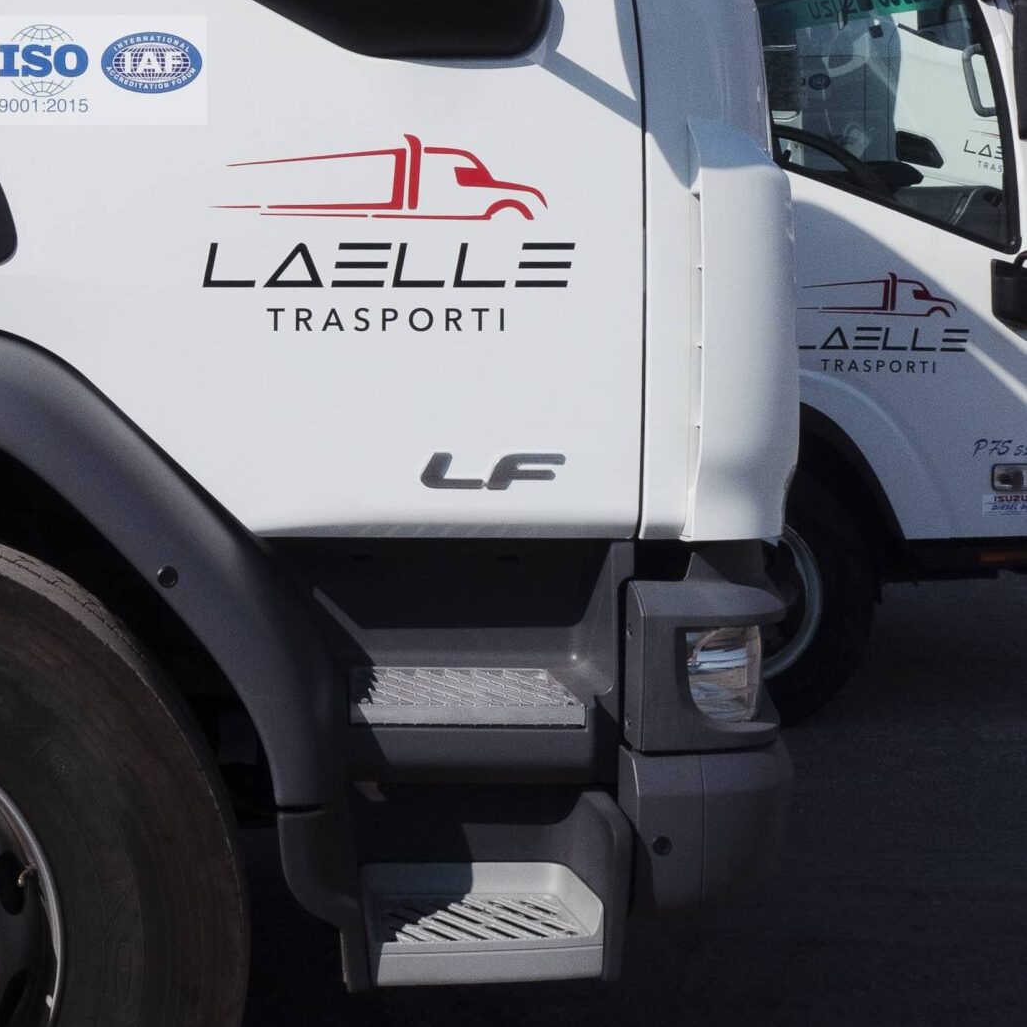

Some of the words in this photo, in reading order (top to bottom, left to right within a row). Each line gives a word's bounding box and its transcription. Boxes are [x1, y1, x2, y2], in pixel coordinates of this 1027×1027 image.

[113, 35, 190, 52] INTERNATIONAL
[124, 51, 182, 74] IAF
[106, 66, 170, 90] ACCREDITATION
[172, 67, 196, 86] FORUM
[202, 243, 576, 288] LAELLE
[267, 307, 506, 332] TRASPORTI
[821, 358, 936, 374] TRASPORTI
[420, 452, 567, 491] LF
